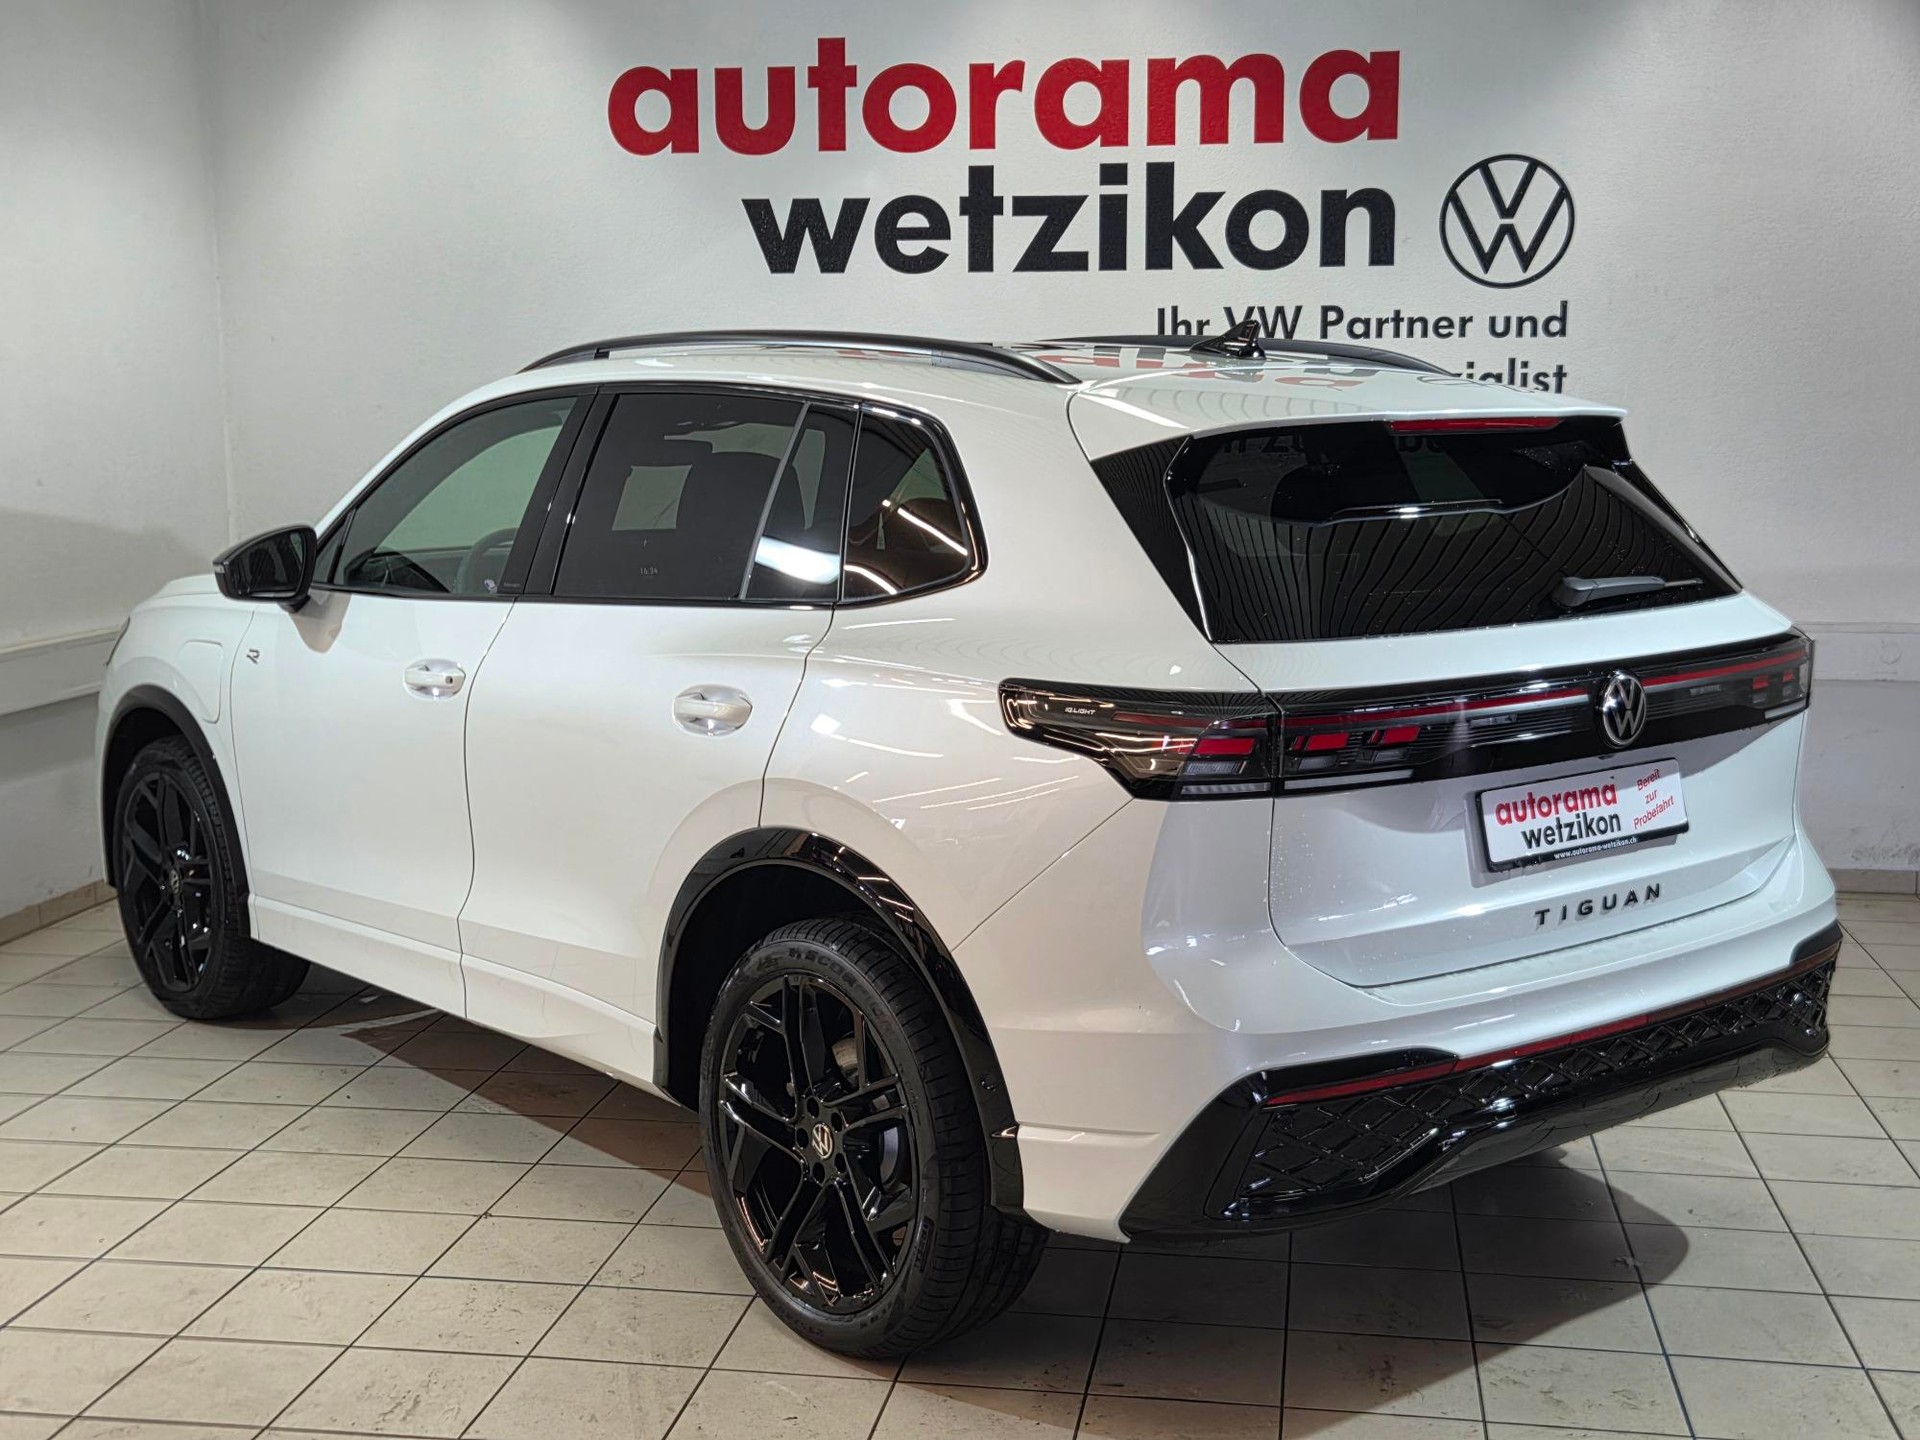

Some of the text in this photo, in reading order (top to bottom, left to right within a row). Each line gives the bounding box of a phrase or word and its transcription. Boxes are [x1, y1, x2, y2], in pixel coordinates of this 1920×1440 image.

[608, 37, 1400, 155] autorama
[741, 161, 1396, 275] wetzikon
[1157, 300, 1568, 341] Ihr VW Partner und
[1637, 768, 1661, 791] Bereit
[1645, 789, 1658, 804] zur
[1495, 783, 1618, 826] autorama
[1633, 795, 1675, 830] Probefahrt
[1521, 811, 1622, 849] wetzikon
[1553, 836, 1638, 860] www.autorama-wetzikon.ch
[1534, 882, 1661, 927] TIGUAN
